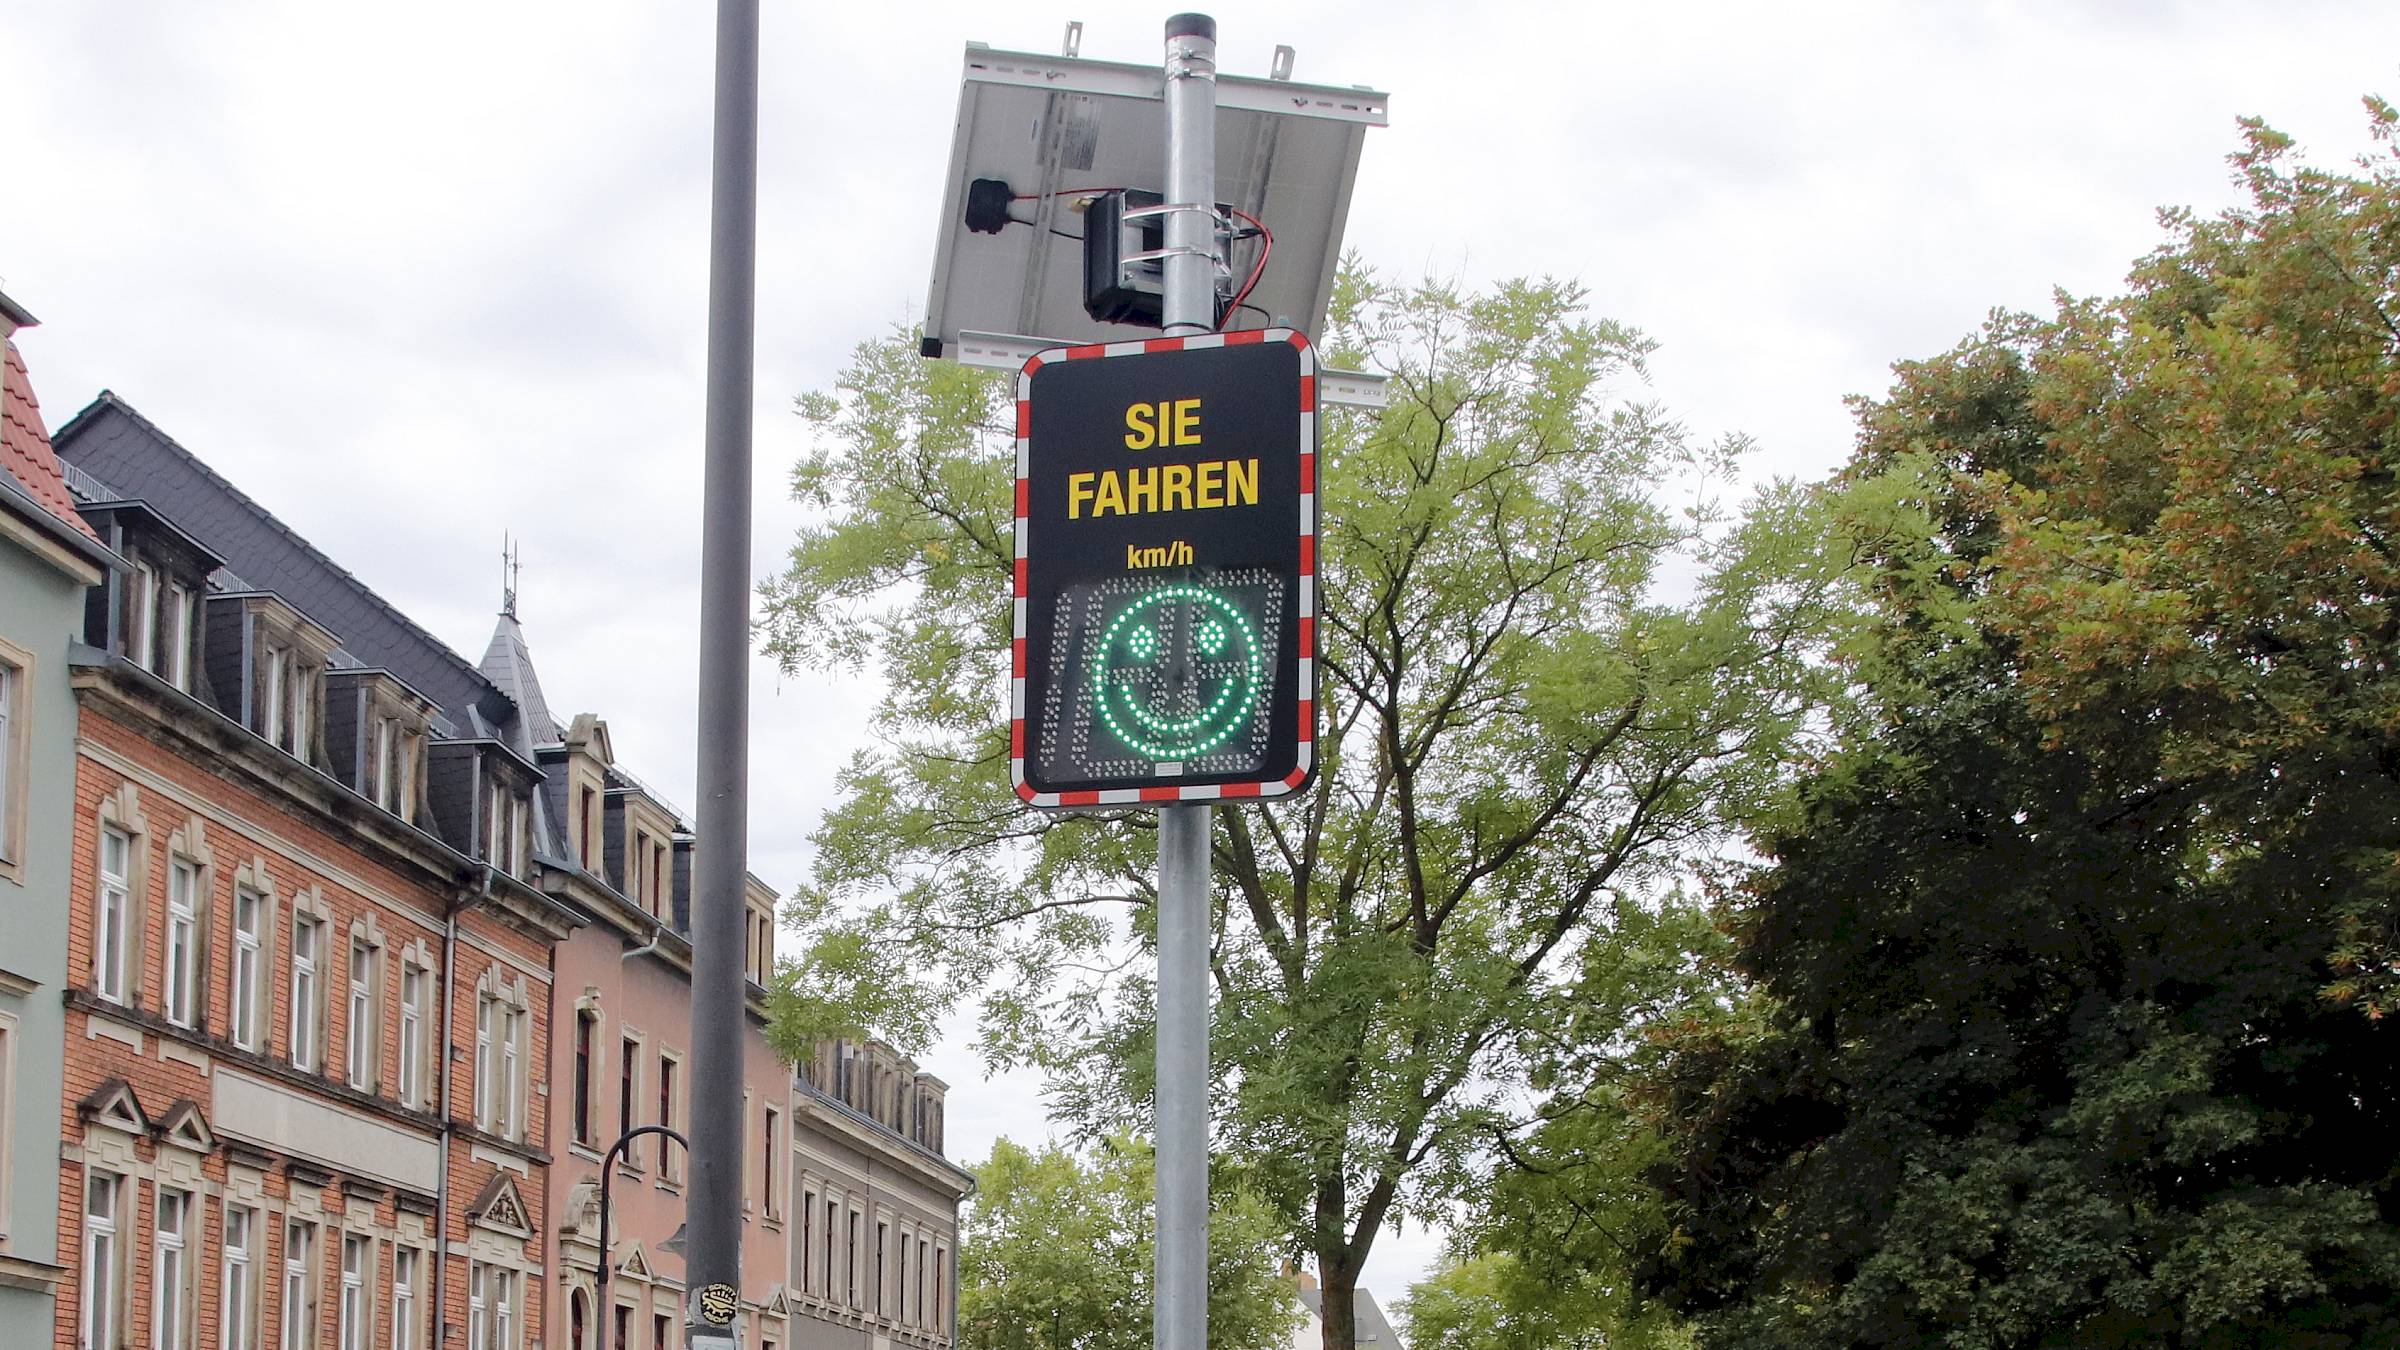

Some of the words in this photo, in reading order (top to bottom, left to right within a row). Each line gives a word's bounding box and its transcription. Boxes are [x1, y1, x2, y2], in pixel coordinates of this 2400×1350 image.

[1125, 398, 1202, 450] SIE
[1068, 459, 1259, 520] FAHREN
[1127, 541, 1194, 569] km/h
[708, 1283, 737, 1297] SCHUTT
